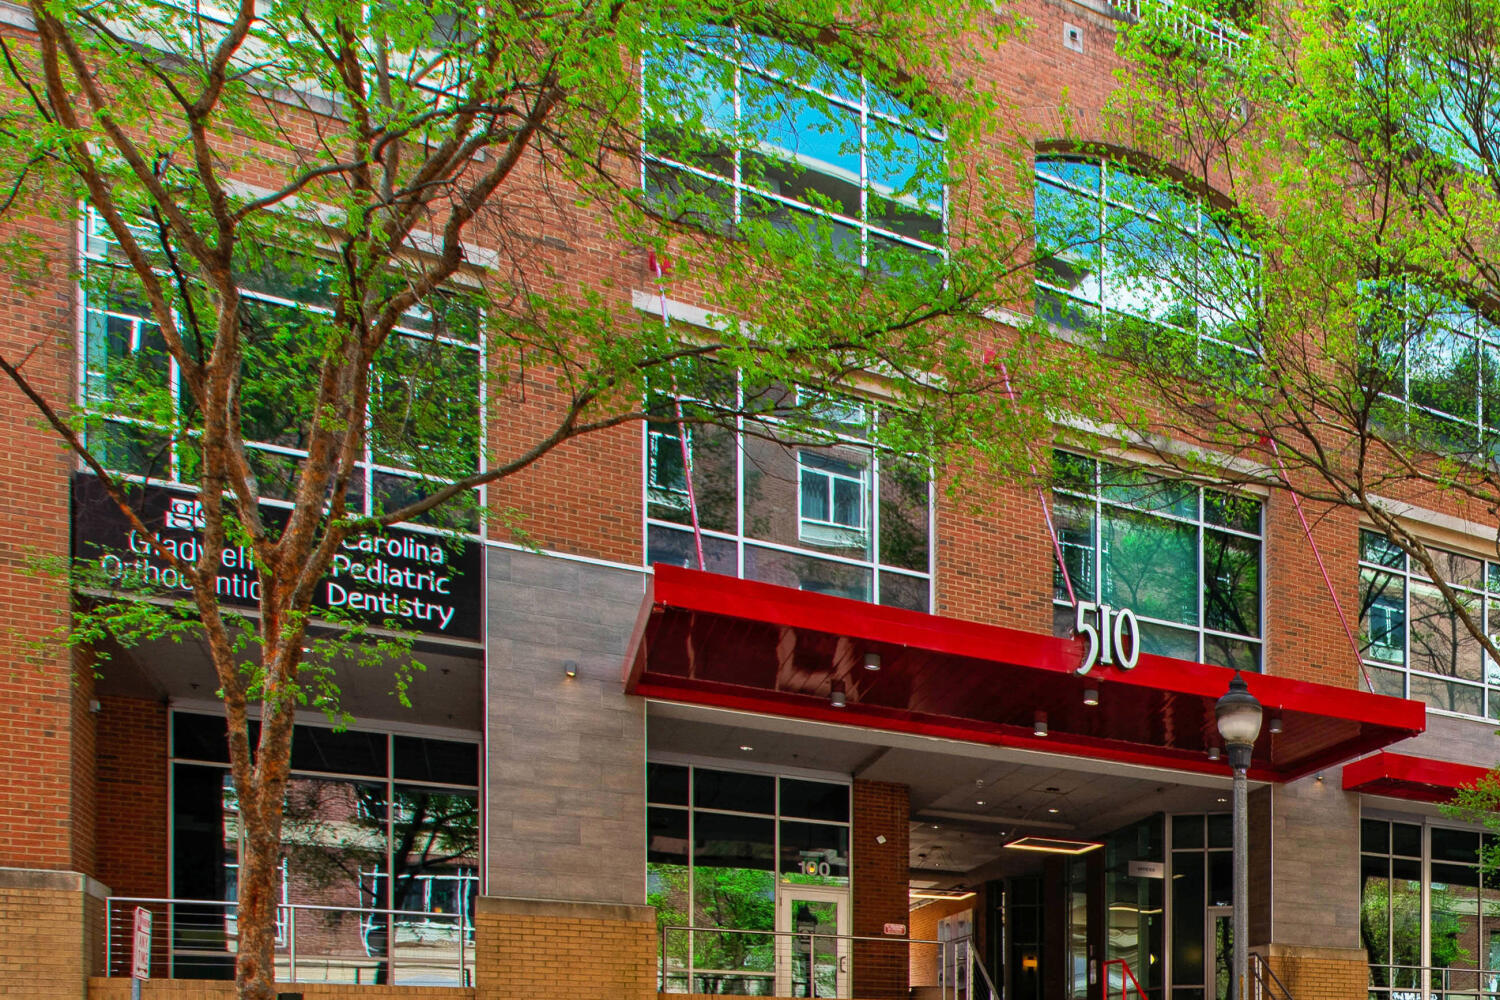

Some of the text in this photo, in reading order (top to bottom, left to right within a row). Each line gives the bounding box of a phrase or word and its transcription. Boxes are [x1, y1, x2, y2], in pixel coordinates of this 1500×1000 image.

[129, 529, 254, 571] Gladell
[333, 553, 450, 595] Pediatric
[326, 581, 455, 630] Dentistry
[1075, 601, 1140, 675] 510
[798, 860, 831, 877] 100
